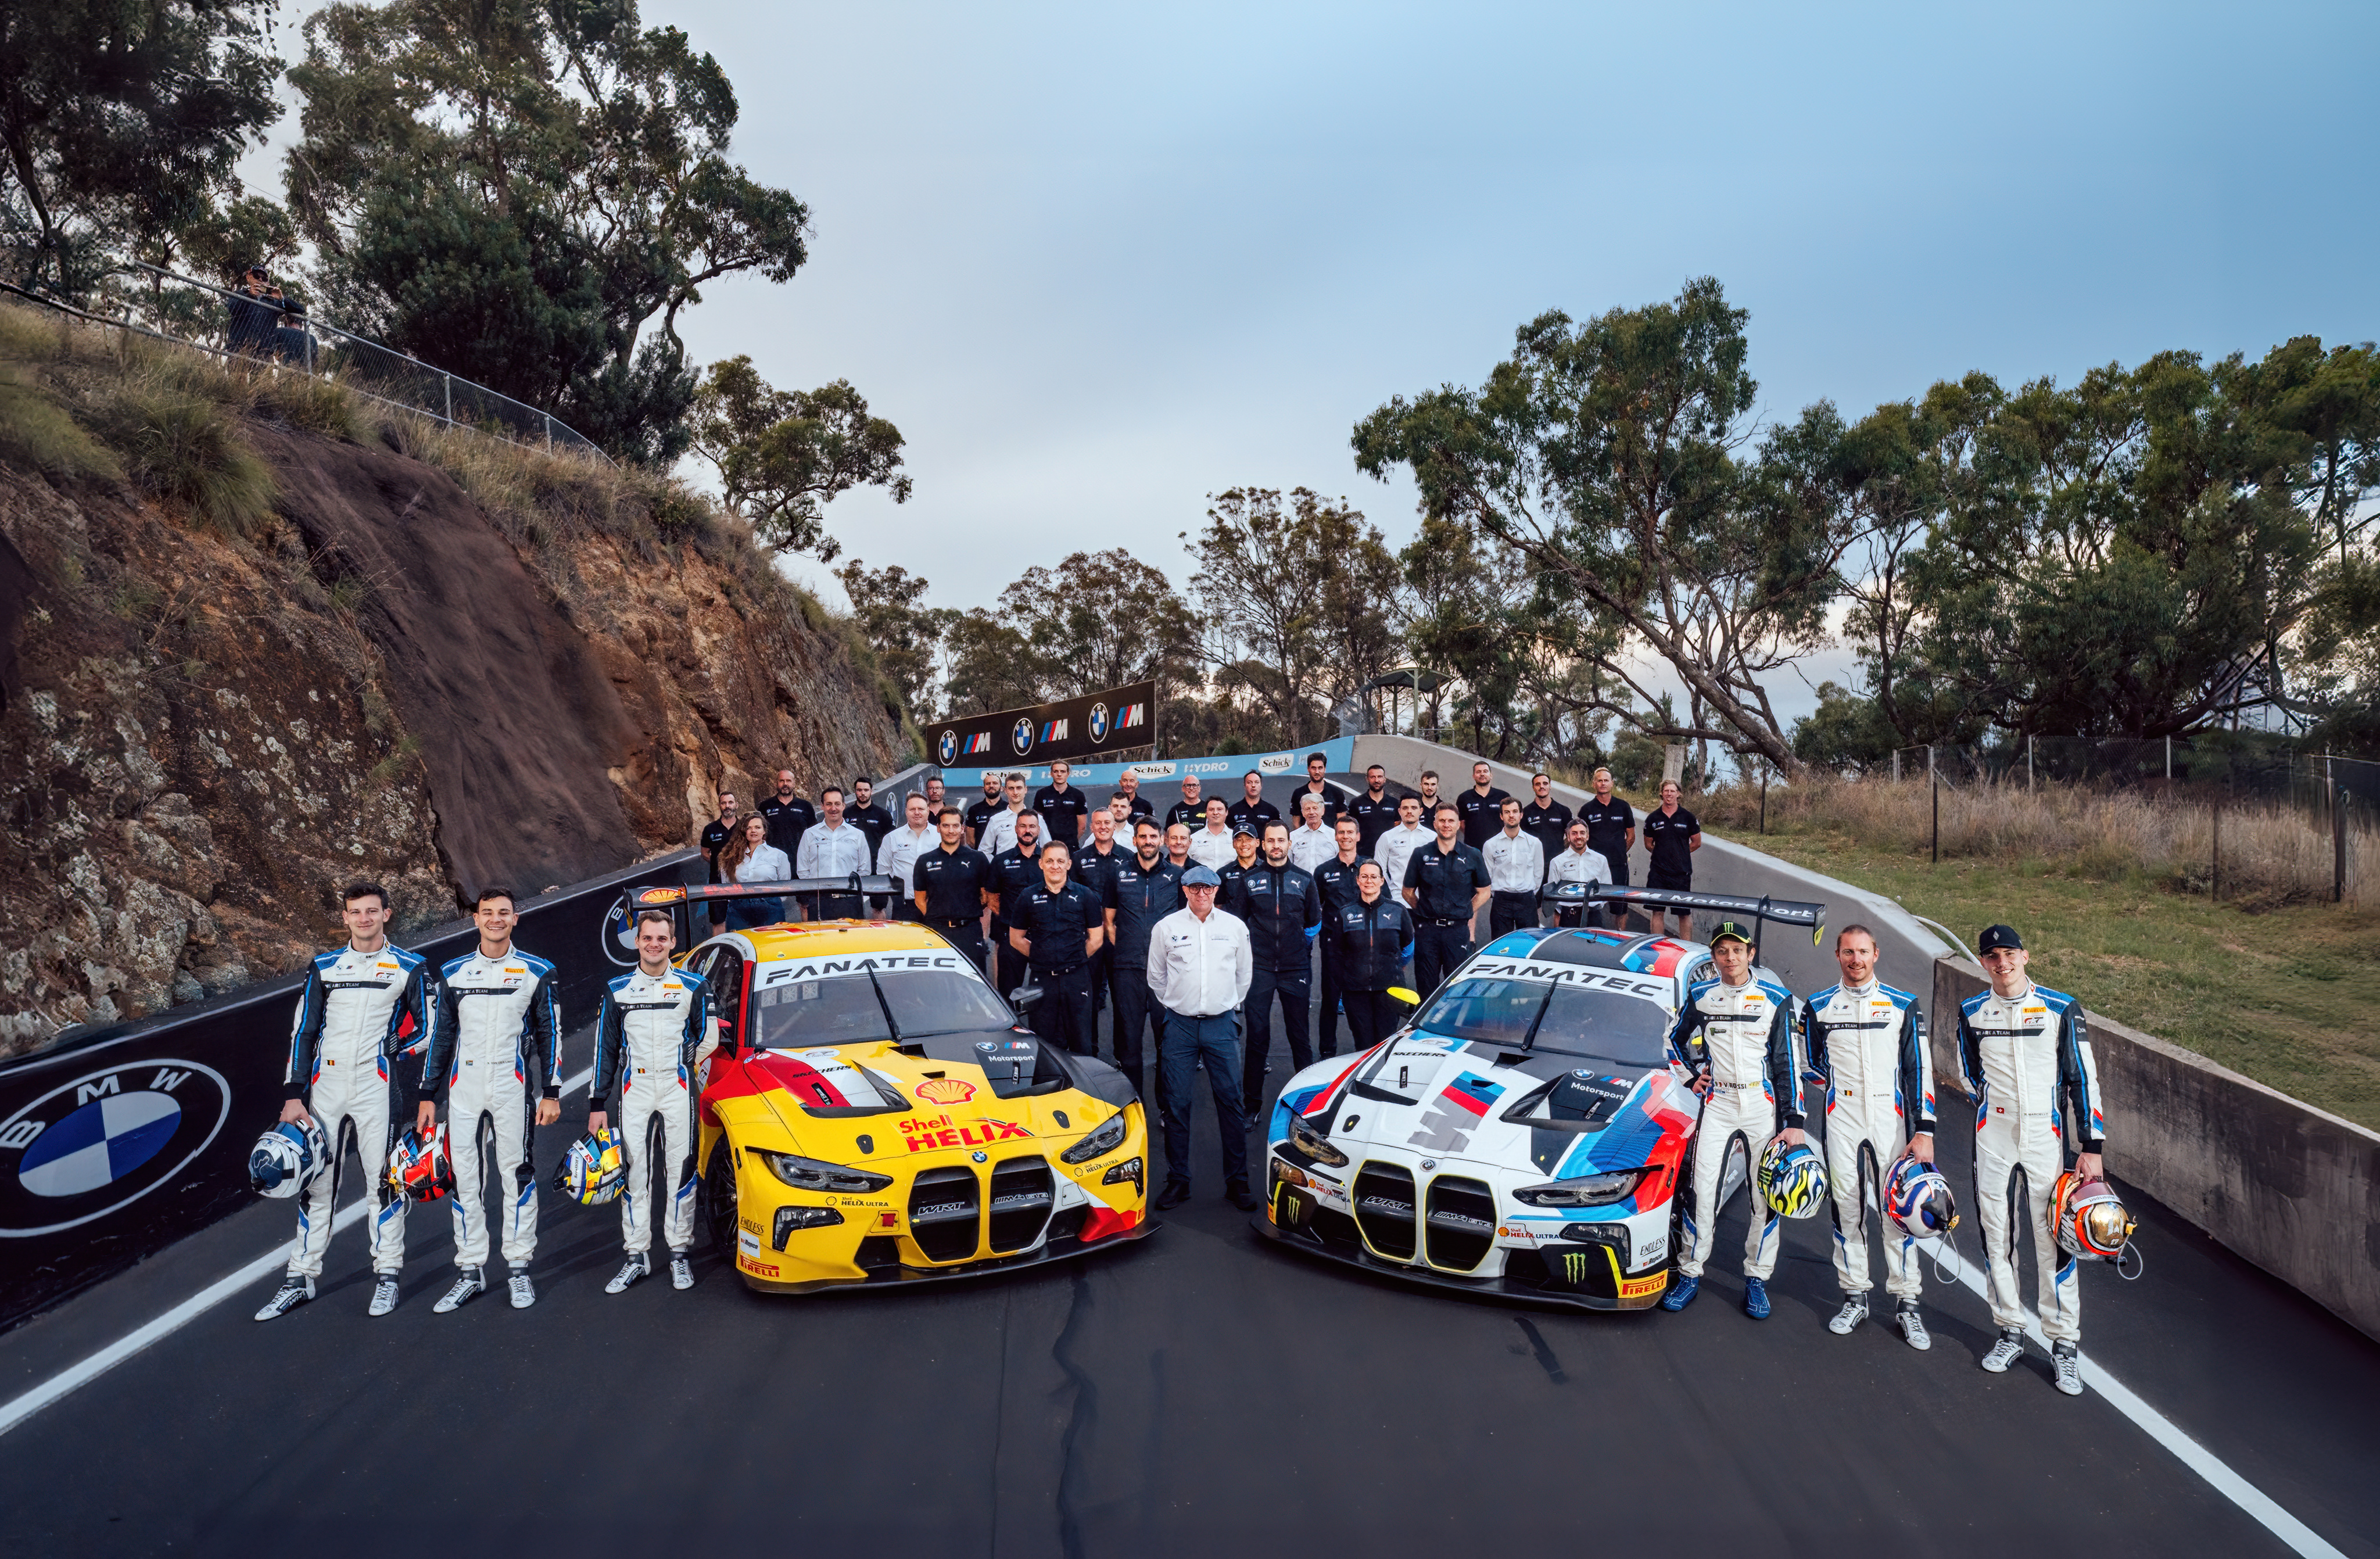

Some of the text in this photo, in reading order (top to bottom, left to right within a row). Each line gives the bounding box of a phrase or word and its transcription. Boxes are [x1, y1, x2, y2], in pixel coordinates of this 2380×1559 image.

[1134, 762, 1228, 775] Schick HYDRO
[1262, 758, 1291, 769] Schick
[765, 956, 956, 985] FANATEC
[1467, 963, 1664, 997] FANATEC
[791, 1065, 852, 1078] SKECHERS
[1571, 1081, 1625, 1101] Motorsport
[1613, 1078, 1633, 1089] M
[0, 1067, 192, 1149] BMW
[899, 1114, 954, 1134] Shell
[904, 1121, 1033, 1153] HELIX
[1085, 1159, 1119, 1174] HELIX ULTRA
[1316, 1185, 1334, 1196] HELIX
[917, 1201, 965, 1216] WRT
[1364, 1196, 1412, 1210] WRT
[740, 1216, 765, 1234] ENDLESS
[1640, 1235, 1666, 1256] ENDLESS
[740, 1254, 780, 1278] PIRELLI
[1621, 1274, 1665, 1295] PIRELLI
